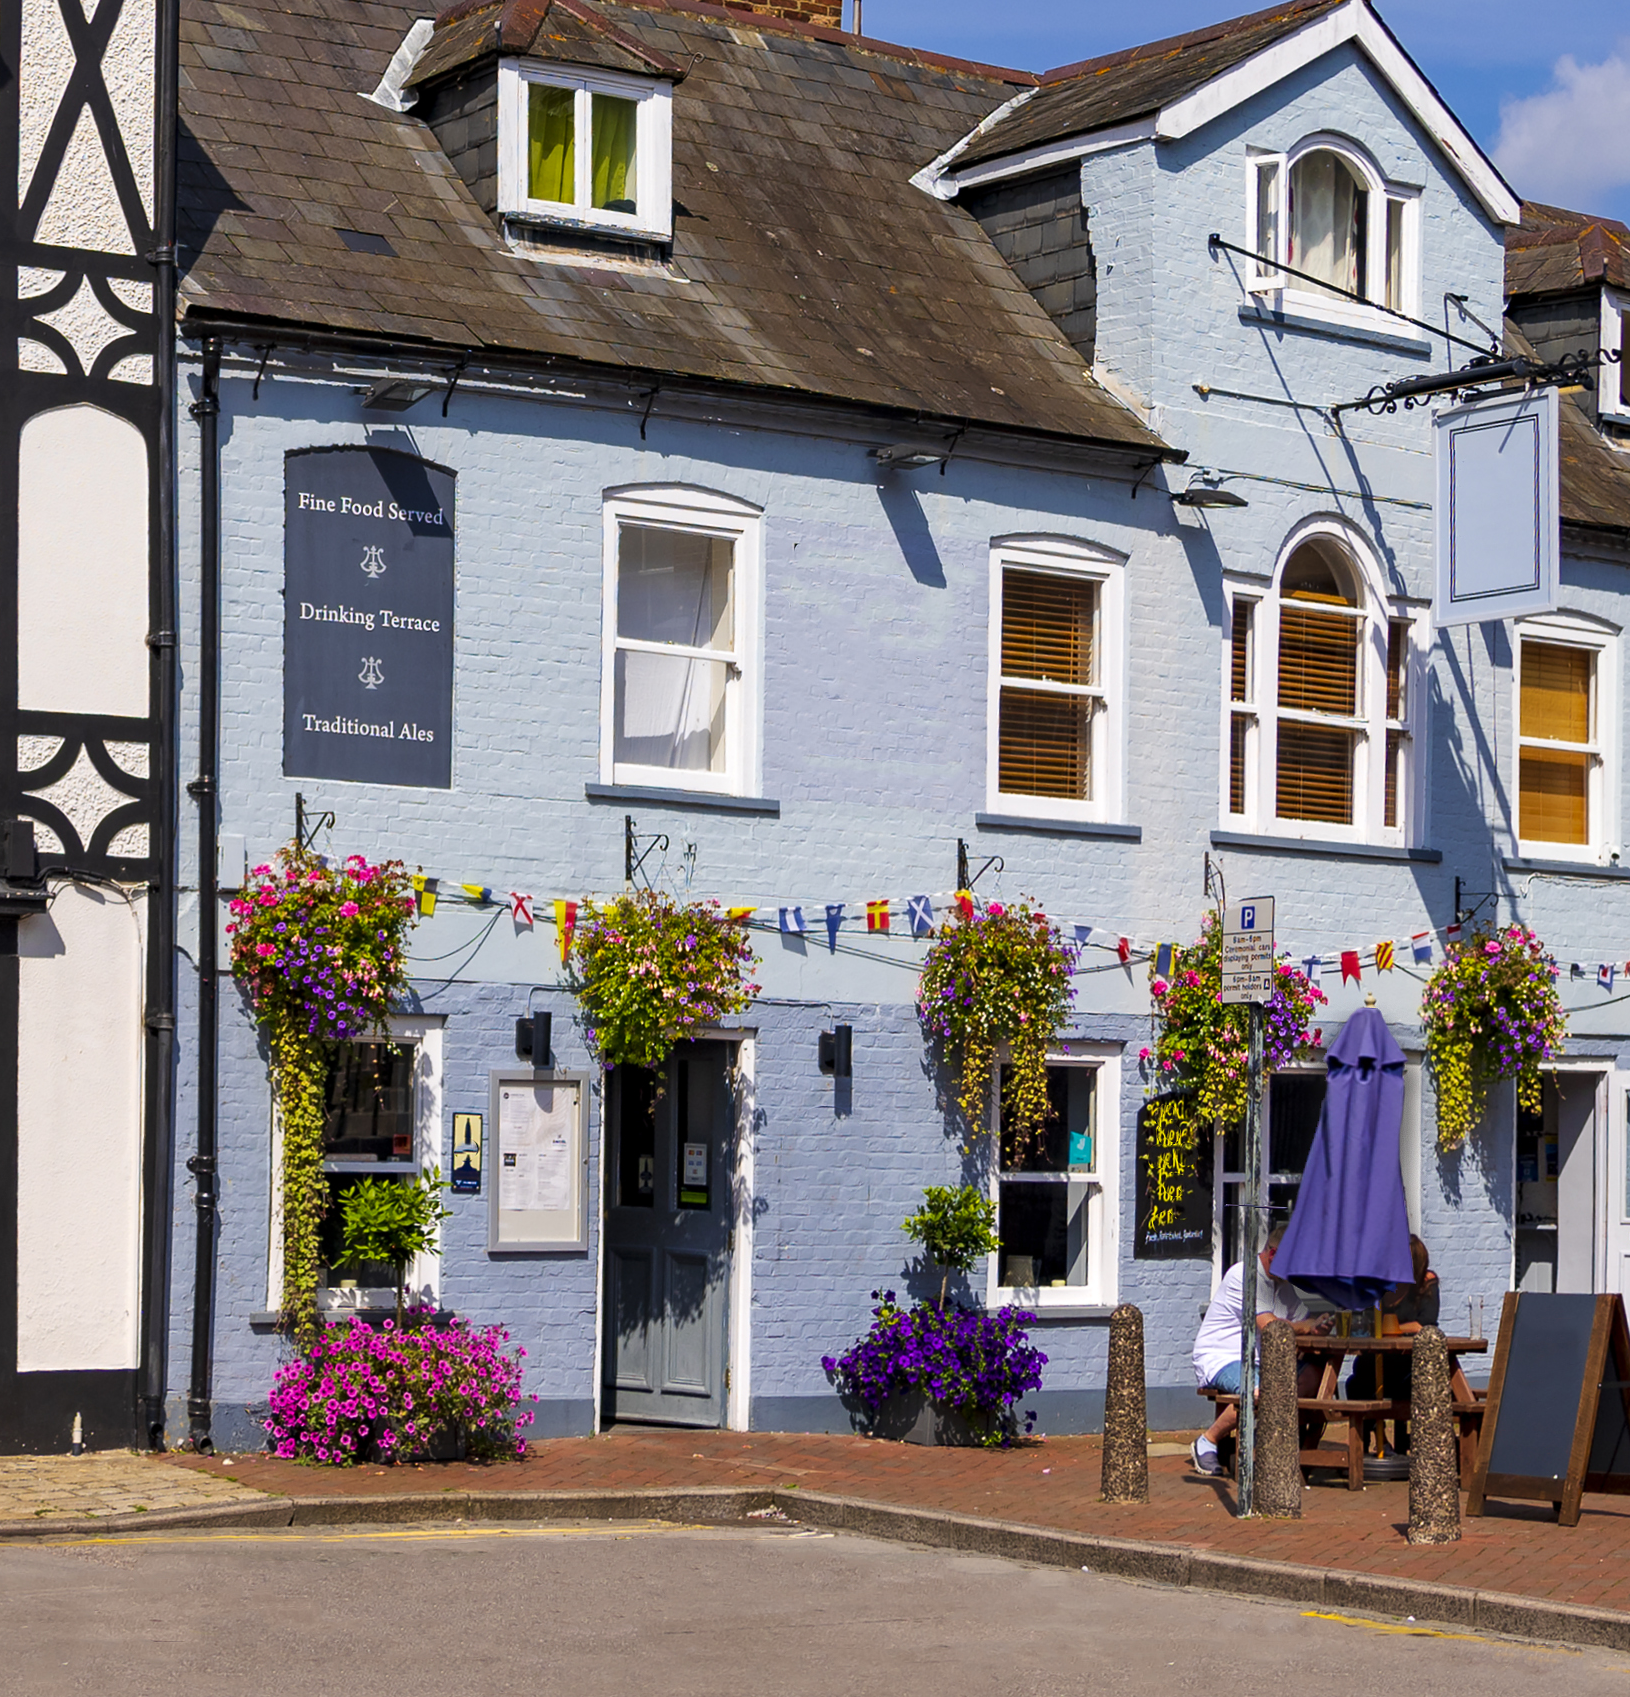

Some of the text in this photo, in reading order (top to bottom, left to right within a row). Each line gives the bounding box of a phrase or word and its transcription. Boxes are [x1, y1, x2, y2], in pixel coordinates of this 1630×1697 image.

[298, 493, 443, 525] Fine Food Served
[299, 602, 440, 632] Drinking Terrace
[302, 713, 434, 743] Traditional Ales
[1244, 909, 1253, 927] P
